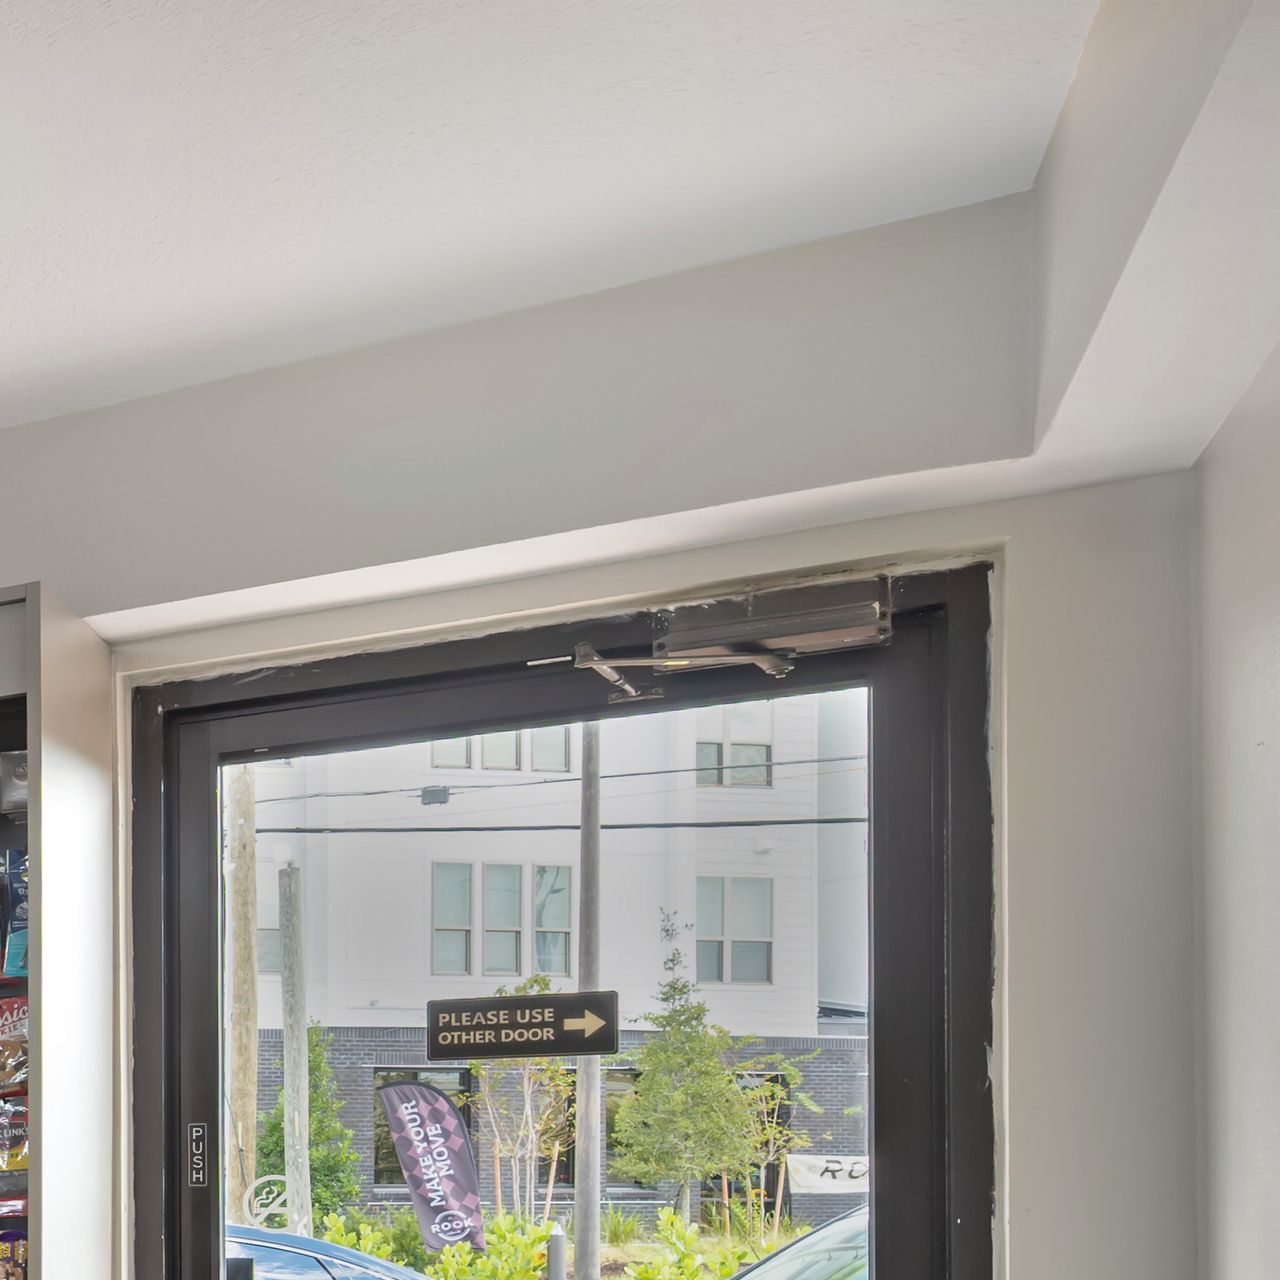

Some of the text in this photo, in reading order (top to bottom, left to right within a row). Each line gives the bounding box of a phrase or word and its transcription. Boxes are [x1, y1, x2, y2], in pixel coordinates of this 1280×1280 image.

[438, 1007, 555, 1027] PLEASE USE
[438, 1026, 555, 1045] OTHER DOOR
[192, 1127, 204, 1183] PUSH
[402, 1100, 446, 1207] MAKE YOUR
[426, 1124, 454, 1176] MOVE
[431, 1217, 474, 1234] ROOK
